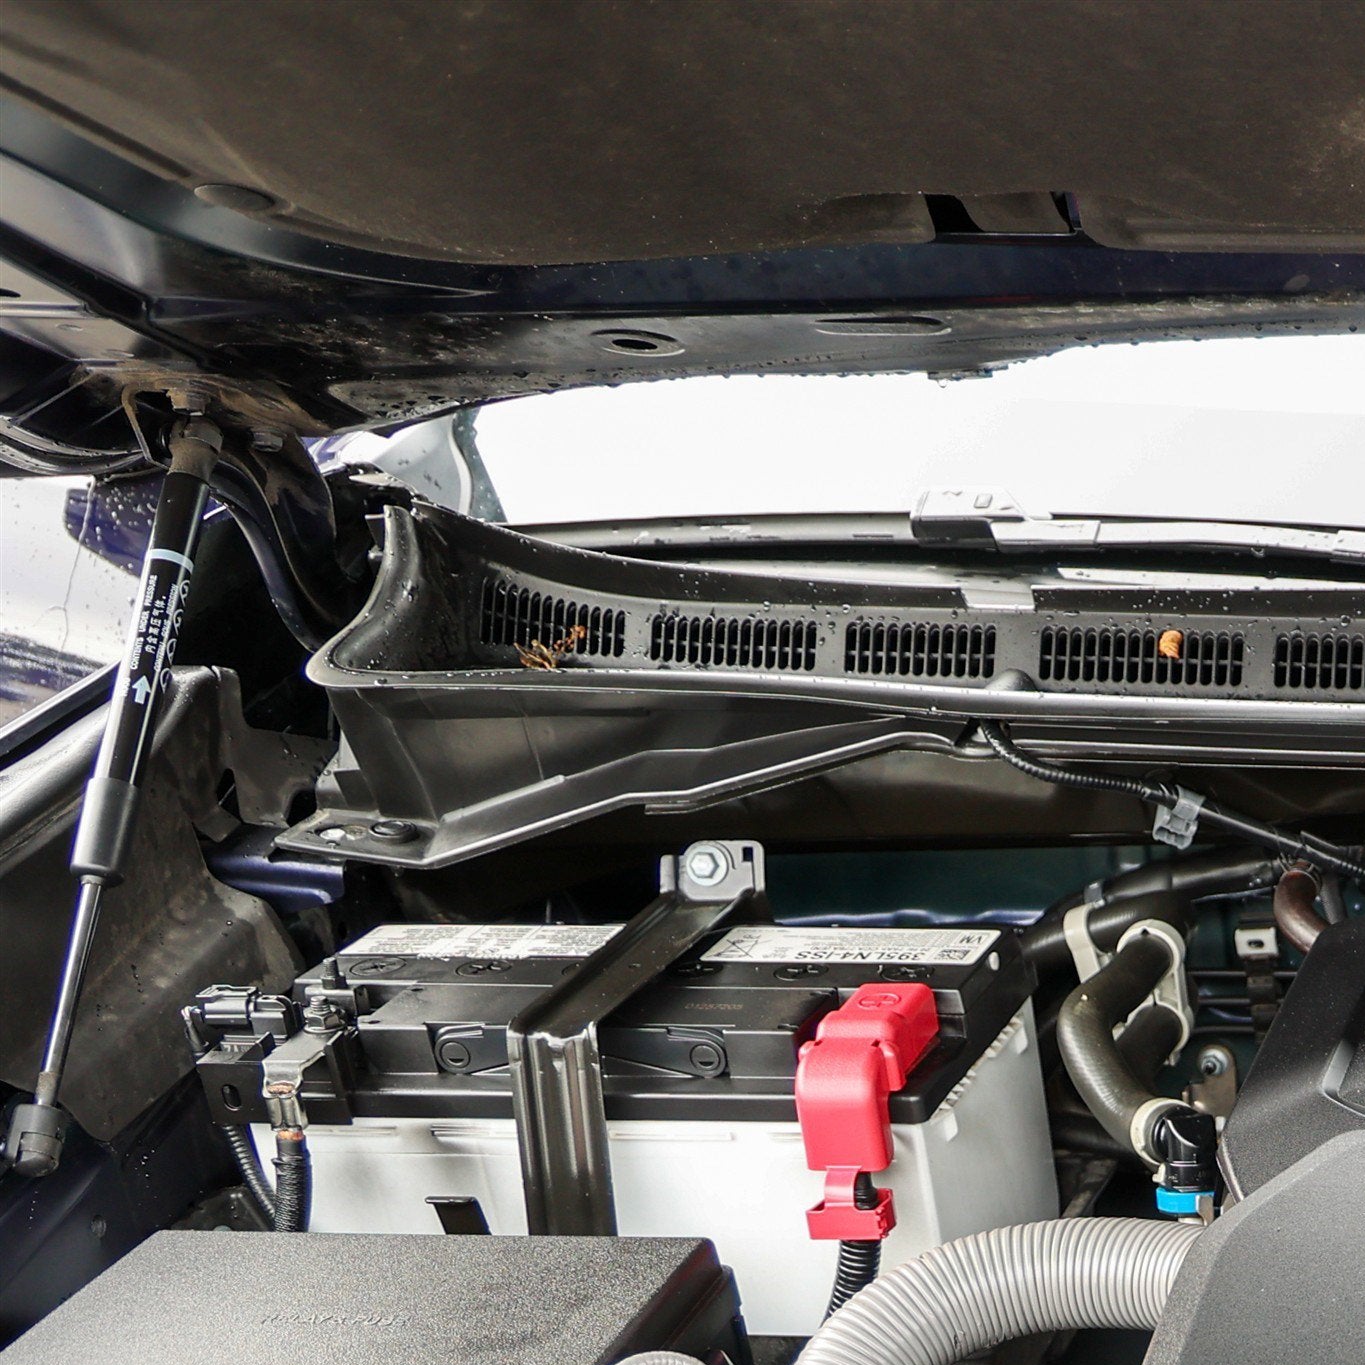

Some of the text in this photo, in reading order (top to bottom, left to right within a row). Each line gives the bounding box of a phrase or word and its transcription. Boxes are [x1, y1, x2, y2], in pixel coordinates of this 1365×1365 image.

[130, 575, 158, 670] CONTENTS UNDER PRESSURE
[959, 935, 985, 944] VM
[795, 951, 925, 961] 395LN4-ISS
